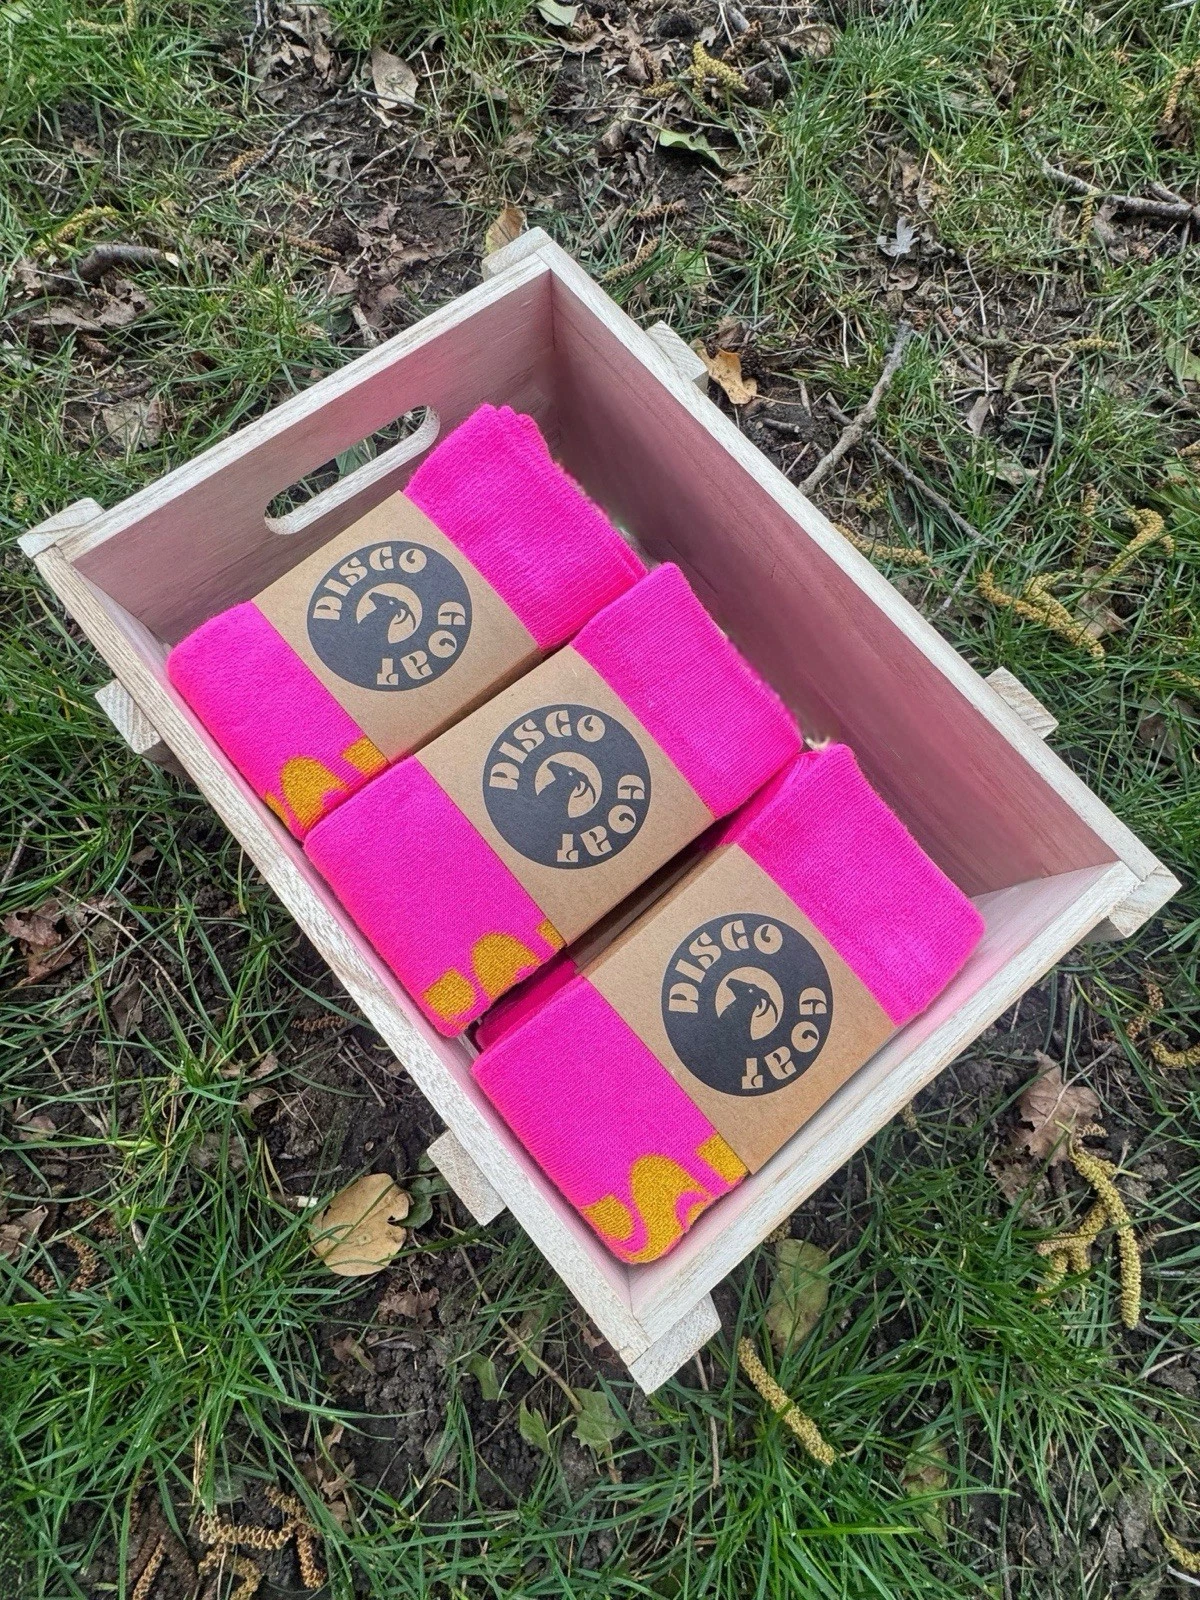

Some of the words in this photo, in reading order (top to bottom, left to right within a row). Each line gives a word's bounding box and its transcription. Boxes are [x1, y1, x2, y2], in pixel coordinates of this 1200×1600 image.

[313, 546, 427, 620] DISCO
[377, 602, 465, 685] GOAT
[489, 710, 605, 790] DISCO
[557, 775, 644, 862] GOAT
[669, 920, 783, 1013] DISCO
[742, 987, 827, 1089] GOAT
